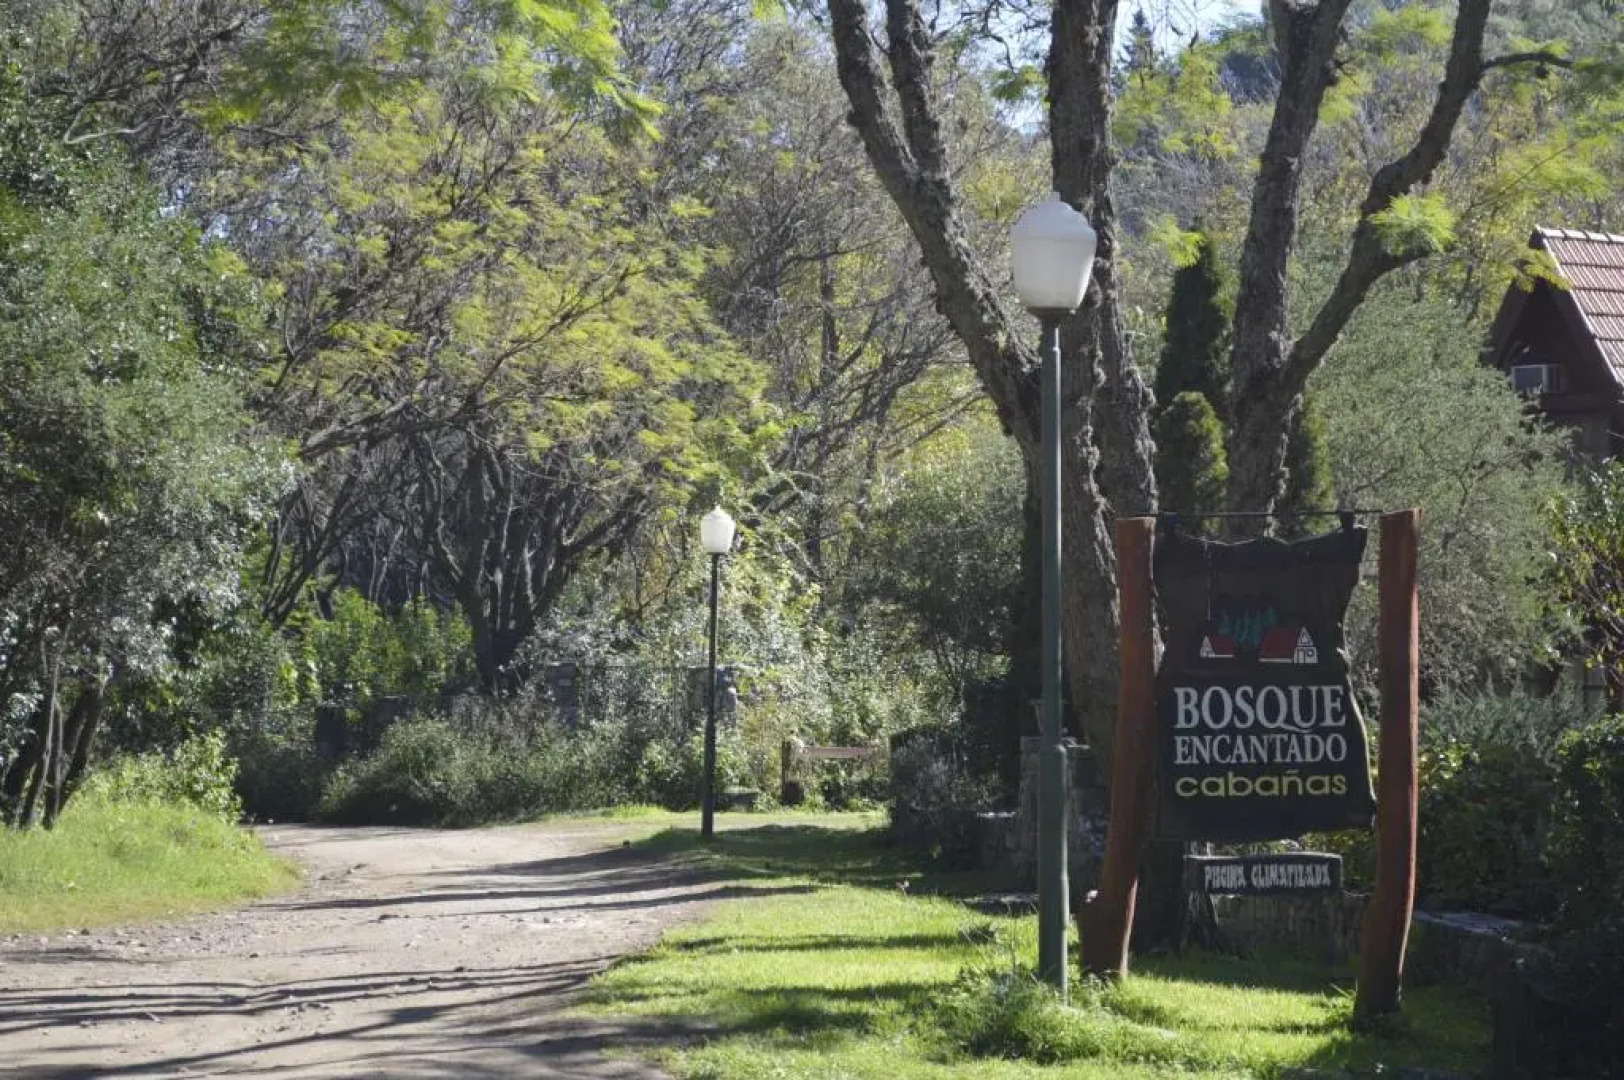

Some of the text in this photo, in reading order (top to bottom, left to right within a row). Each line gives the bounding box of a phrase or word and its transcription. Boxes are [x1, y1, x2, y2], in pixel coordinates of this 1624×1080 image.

[1173, 685, 1346, 733] BOSQUE
[1174, 734, 1347, 764] ENCANTADO
[1175, 769, 1347, 797] cabañas
